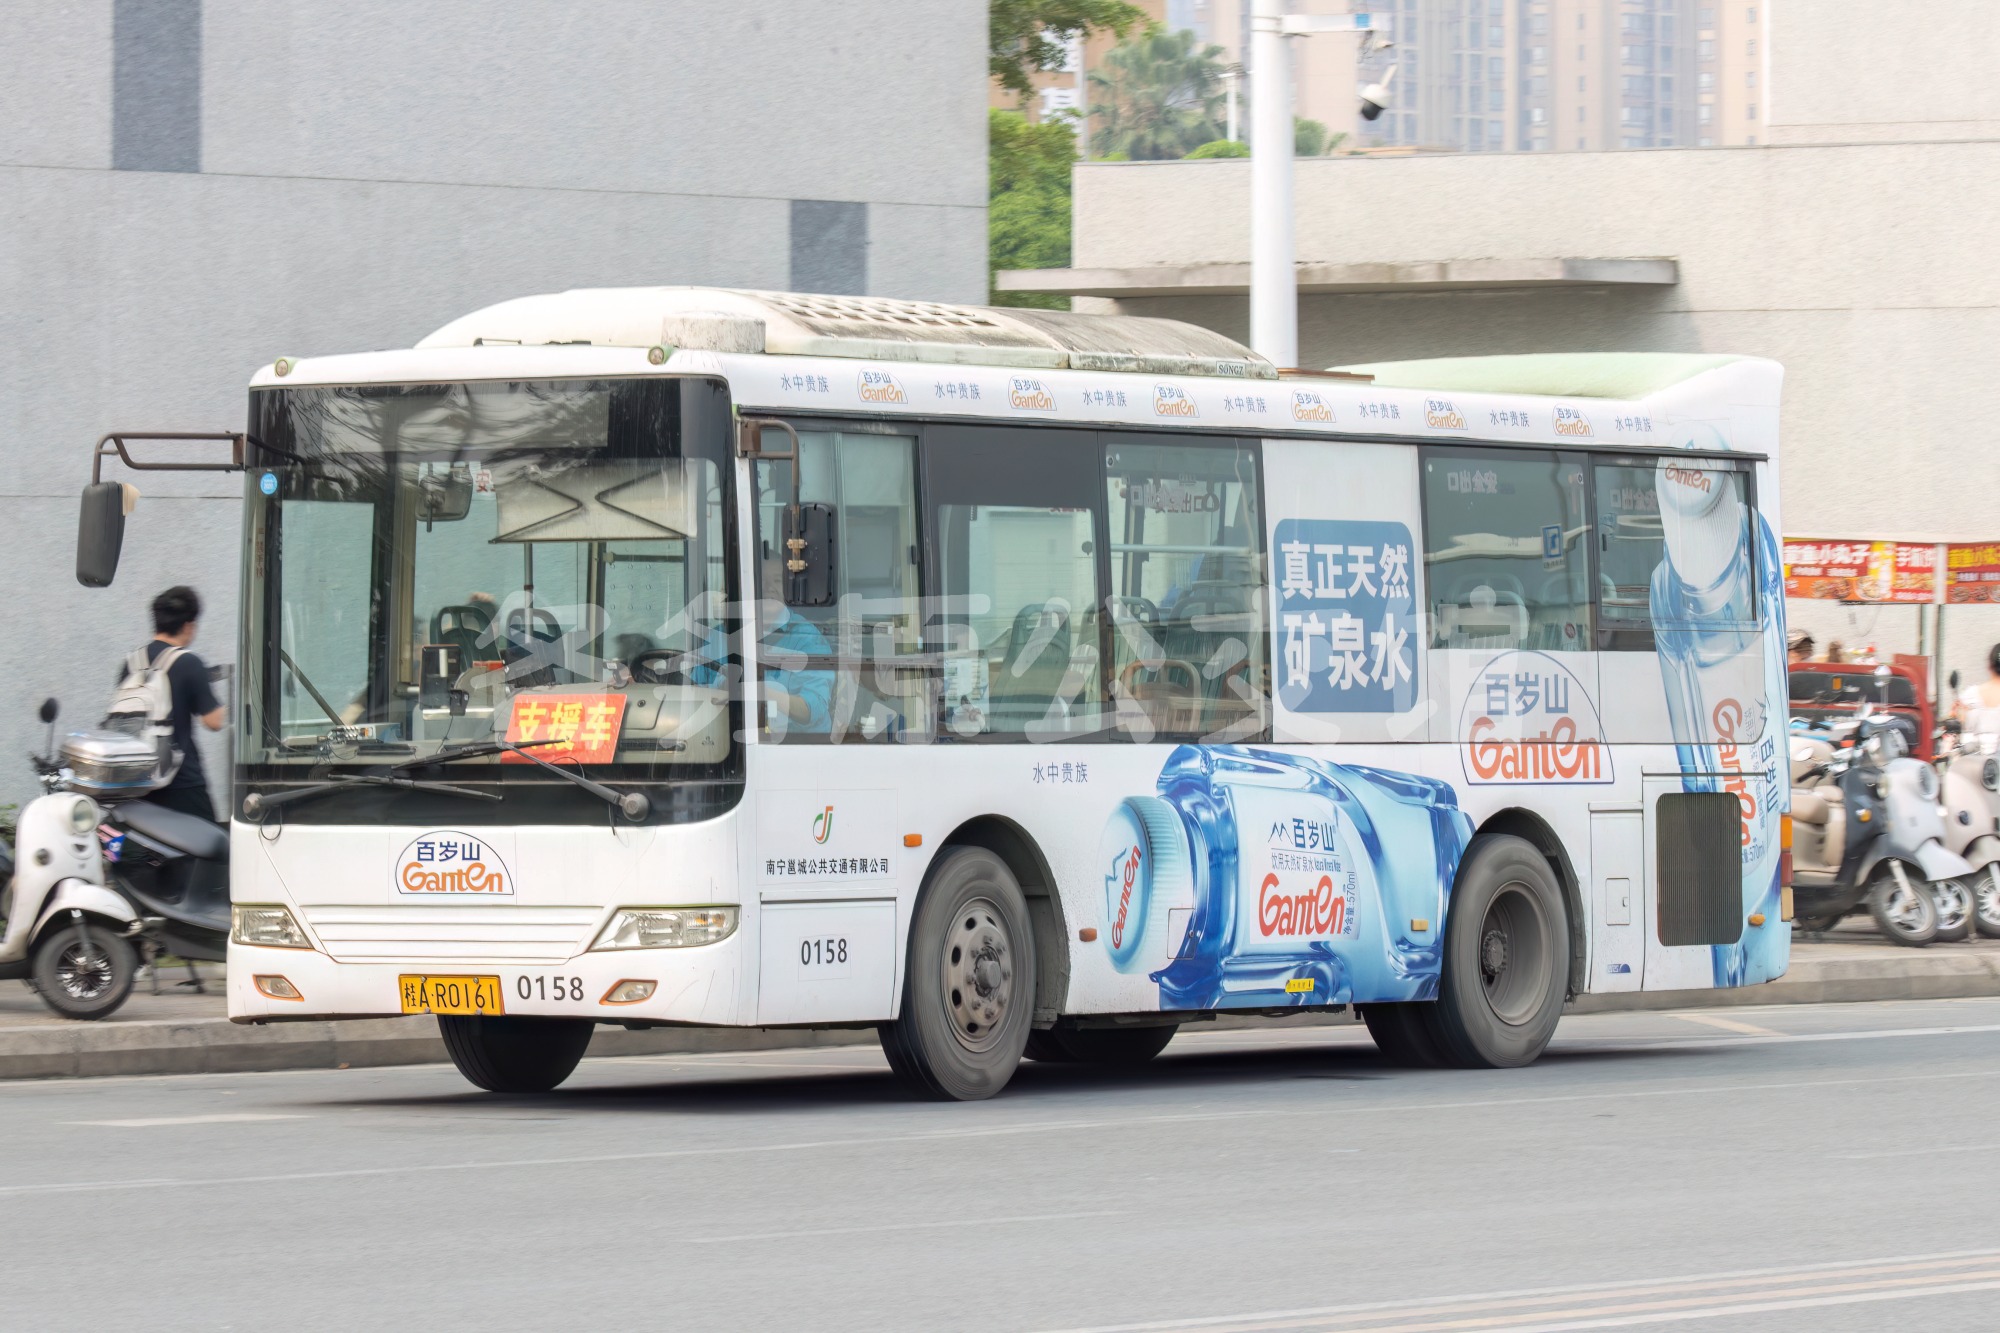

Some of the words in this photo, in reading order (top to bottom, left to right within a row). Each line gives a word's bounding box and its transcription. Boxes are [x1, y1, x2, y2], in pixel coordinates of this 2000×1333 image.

[781, 374, 829, 392] 水中贵族
[863, 371, 891, 383] 百岁山
[1013, 379, 1041, 391] 百岁山
[861, 383, 903, 402] Ganten
[935, 381, 981, 399] 水中贵族
[1083, 388, 1127, 407] 水中贵族
[1157, 386, 1184, 398] 百岁山
[1295, 392, 1321, 404] 百岁山
[1012, 390, 1052, 409] Ganten
[1156, 397, 1197, 416] Ganten
[1224, 395, 1267, 413] 水中贵族
[1428, 400, 1453, 412] 百岁山
[1294, 403, 1332, 421] Ganten
[1359, 402, 1401, 419] 水中贵族
[1490, 409, 1530, 427] 水中贵族
[1556, 407, 1580, 419] 百岁山
[1427, 411, 1464, 429] Ganten
[1555, 418, 1591, 436] Ganten
[1614, 415, 1653, 432] 水中贵族
[1281, 540, 1409, 600] 真正天然
[1284, 612, 1412, 691] 矿泉水
[1485, 672, 1569, 716] 百岁山
[518, 701, 616, 751] 支援车
[1469, 717, 1600, 779] Ganten
[1033, 762, 1088, 784] 水中贵族
[1293, 818, 1335, 852] 百岁山
[417, 841, 481, 862] 百岁山
[766, 858, 889, 875] 南宁邕城公共交通有限公司
[403, 861, 503, 892] Ganten
[1259, 872, 1345, 936] Ganten
[801, 938, 848, 965] 0158
[517, 975, 584, 1001] 0158
